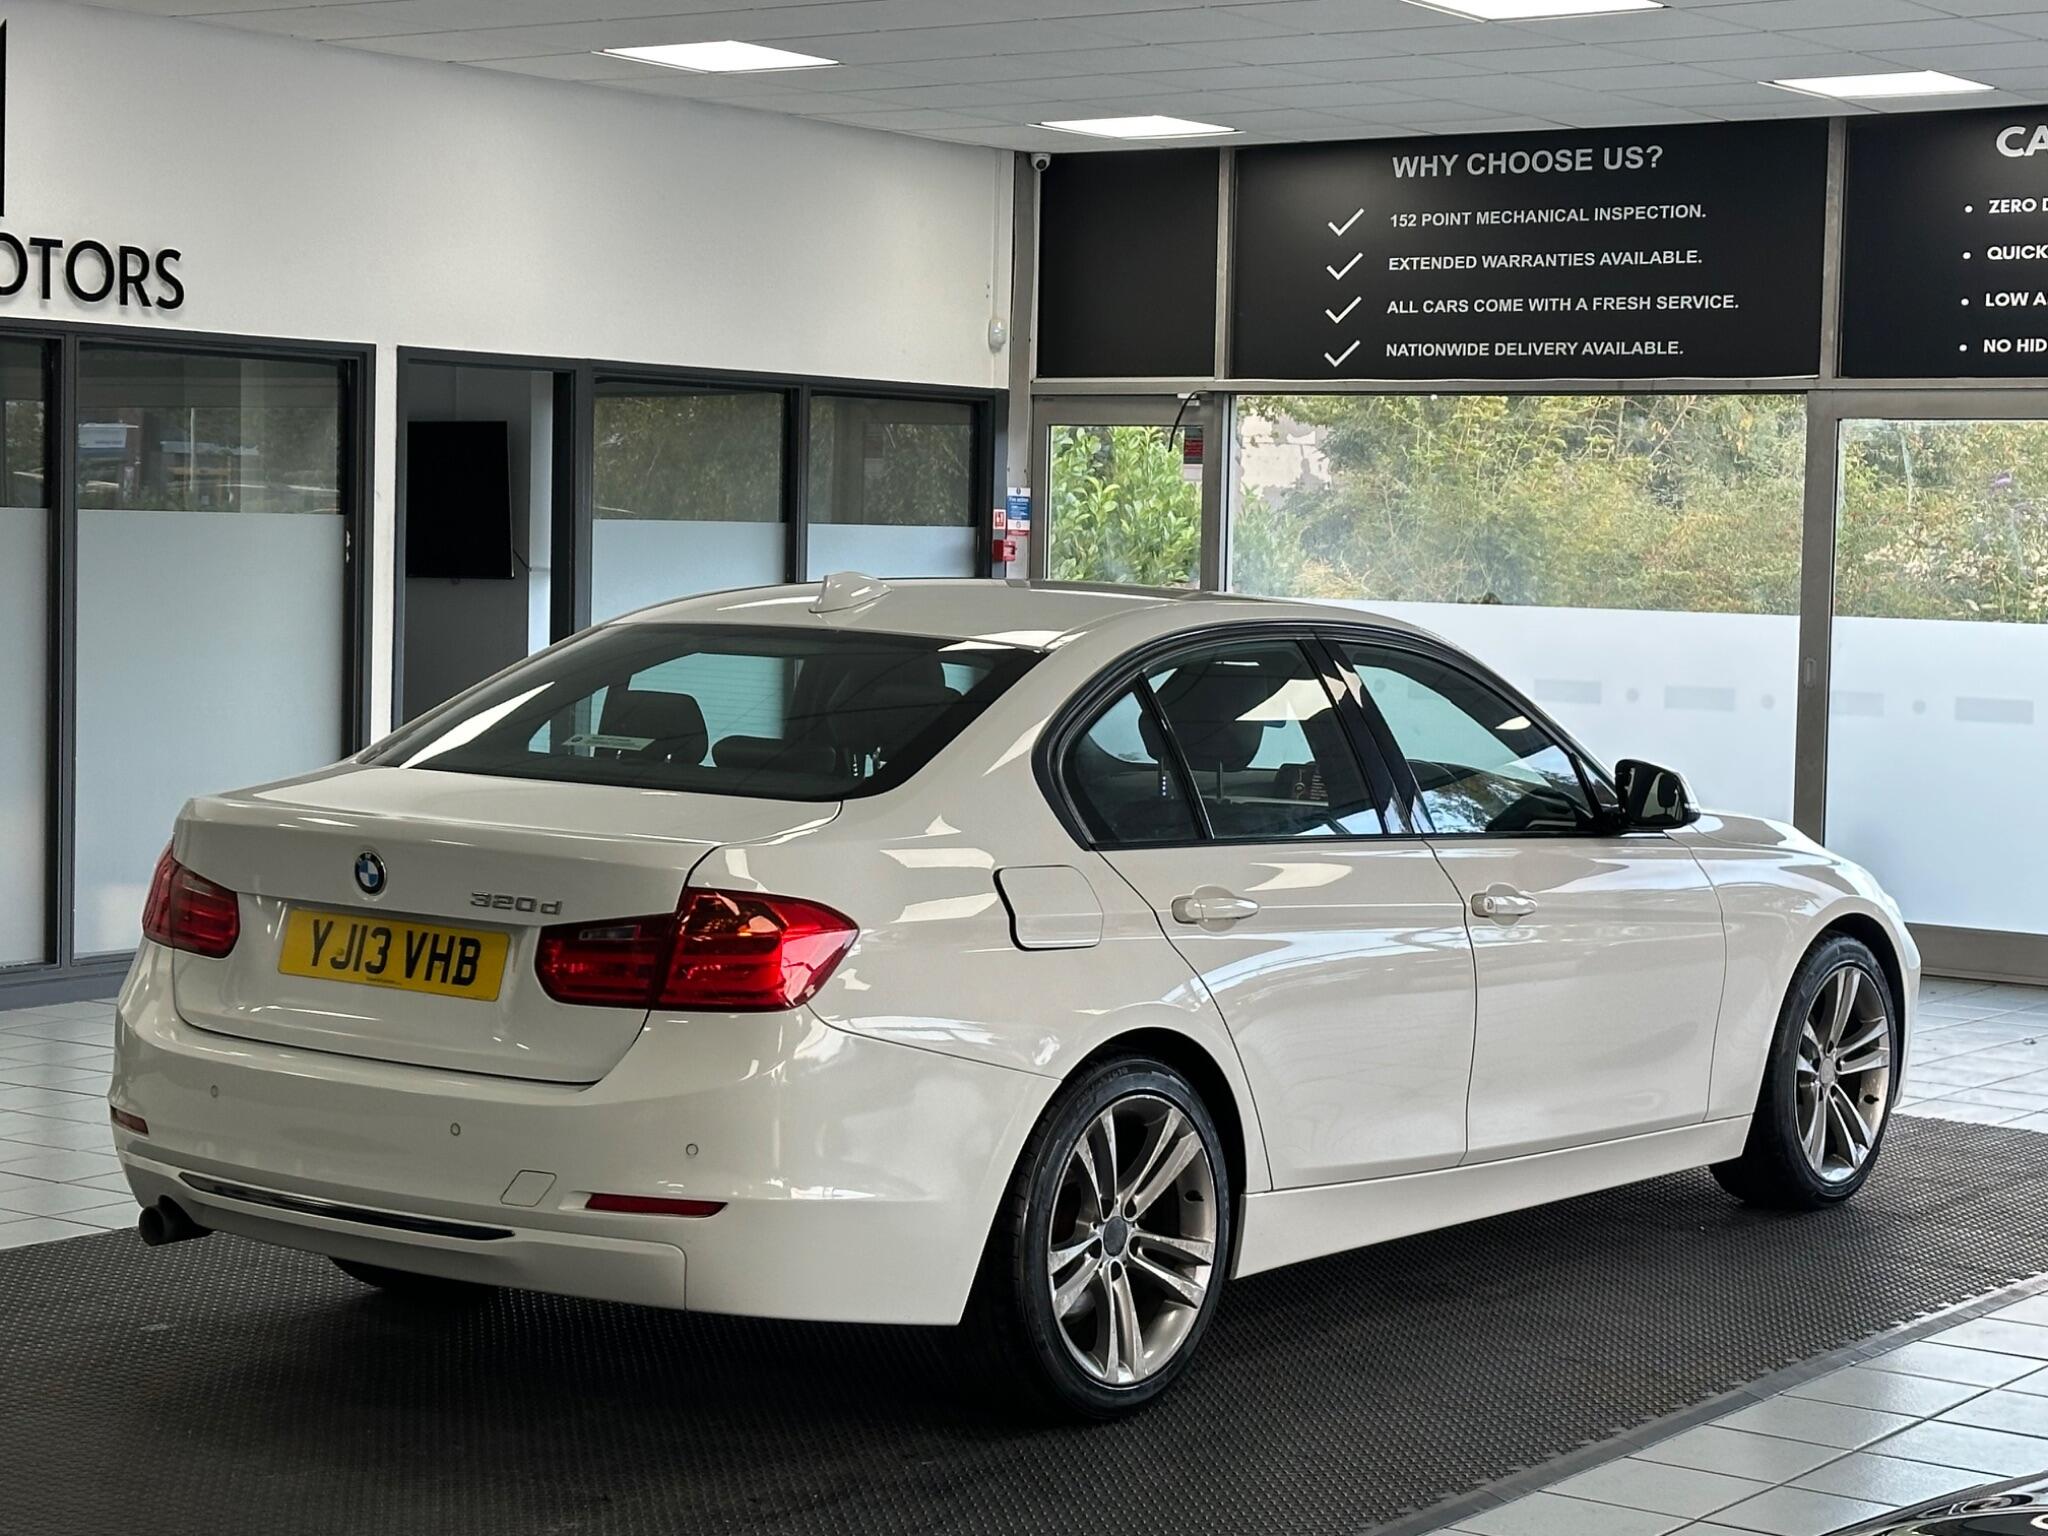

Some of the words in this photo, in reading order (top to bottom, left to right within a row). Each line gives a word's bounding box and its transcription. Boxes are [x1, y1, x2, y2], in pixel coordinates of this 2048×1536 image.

[1996, 125, 2048, 158] CA
[1392, 155, 1459, 179] WHY
[1466, 149, 1593, 176] CHOOSE
[1603, 145, 1663, 170] US?
[1390, 213, 1417, 228] 152
[1421, 212, 1472, 227] POINT
[1476, 208, 1590, 225] MECHANICAL
[1594, 204, 1707, 222] INSPECTION.
[1988, 198, 2038, 214] ZERO
[1388, 255, 1478, 271] EXTENDED
[1481, 252, 1596, 269] WARRANTIES
[1599, 249, 1703, 266] AVAILABLE.
[1986, 244, 2048, 261] QUICK
[1386, 300, 1419, 314] ALL
[1422, 299, 1469, 314] CARS
[1473, 298, 1524, 313] COME
[1527, 297, 1572, 312] WITH
[1574, 297, 1589, 311] A
[1592, 296, 1651, 311] FRESH
[1656, 294, 1739, 310] SERVICE.
[1985, 292, 2030, 307] LOW
[1386, 342, 1490, 357] NATIONWIDE
[1494, 341, 1579, 357] DELIVERY
[1581, 340, 1684, 356] AVAILABLE.
[1983, 338, 2012, 353] NO
[470, 892, 563, 916] 320d
[311, 919, 392, 975] YJ13
[405, 929, 482, 987] VHB
